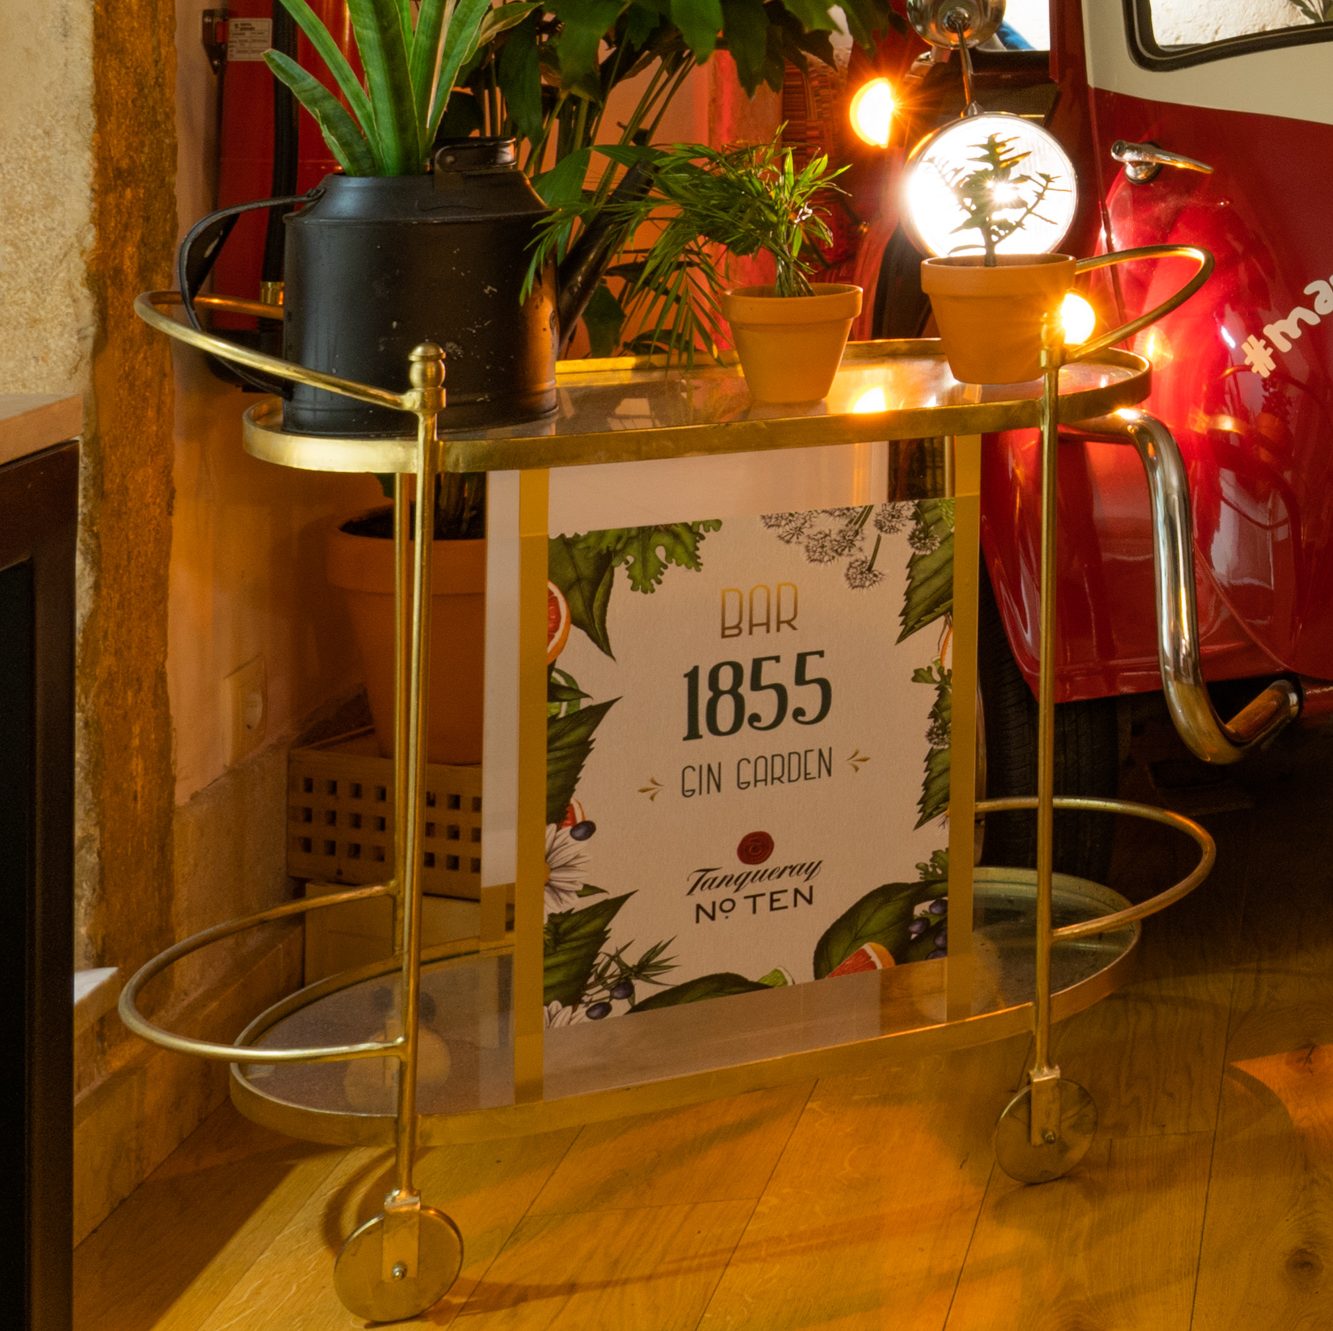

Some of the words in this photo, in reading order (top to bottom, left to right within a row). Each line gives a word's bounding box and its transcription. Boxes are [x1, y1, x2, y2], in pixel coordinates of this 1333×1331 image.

[721, 582, 798, 639] BAR
[682, 650, 833, 741] 1855
[681, 761, 721, 798] GIN
[736, 746, 832, 790] GARDEN
[685, 859, 823, 897] Tanqueray
[743, 885, 813, 915] TEN
